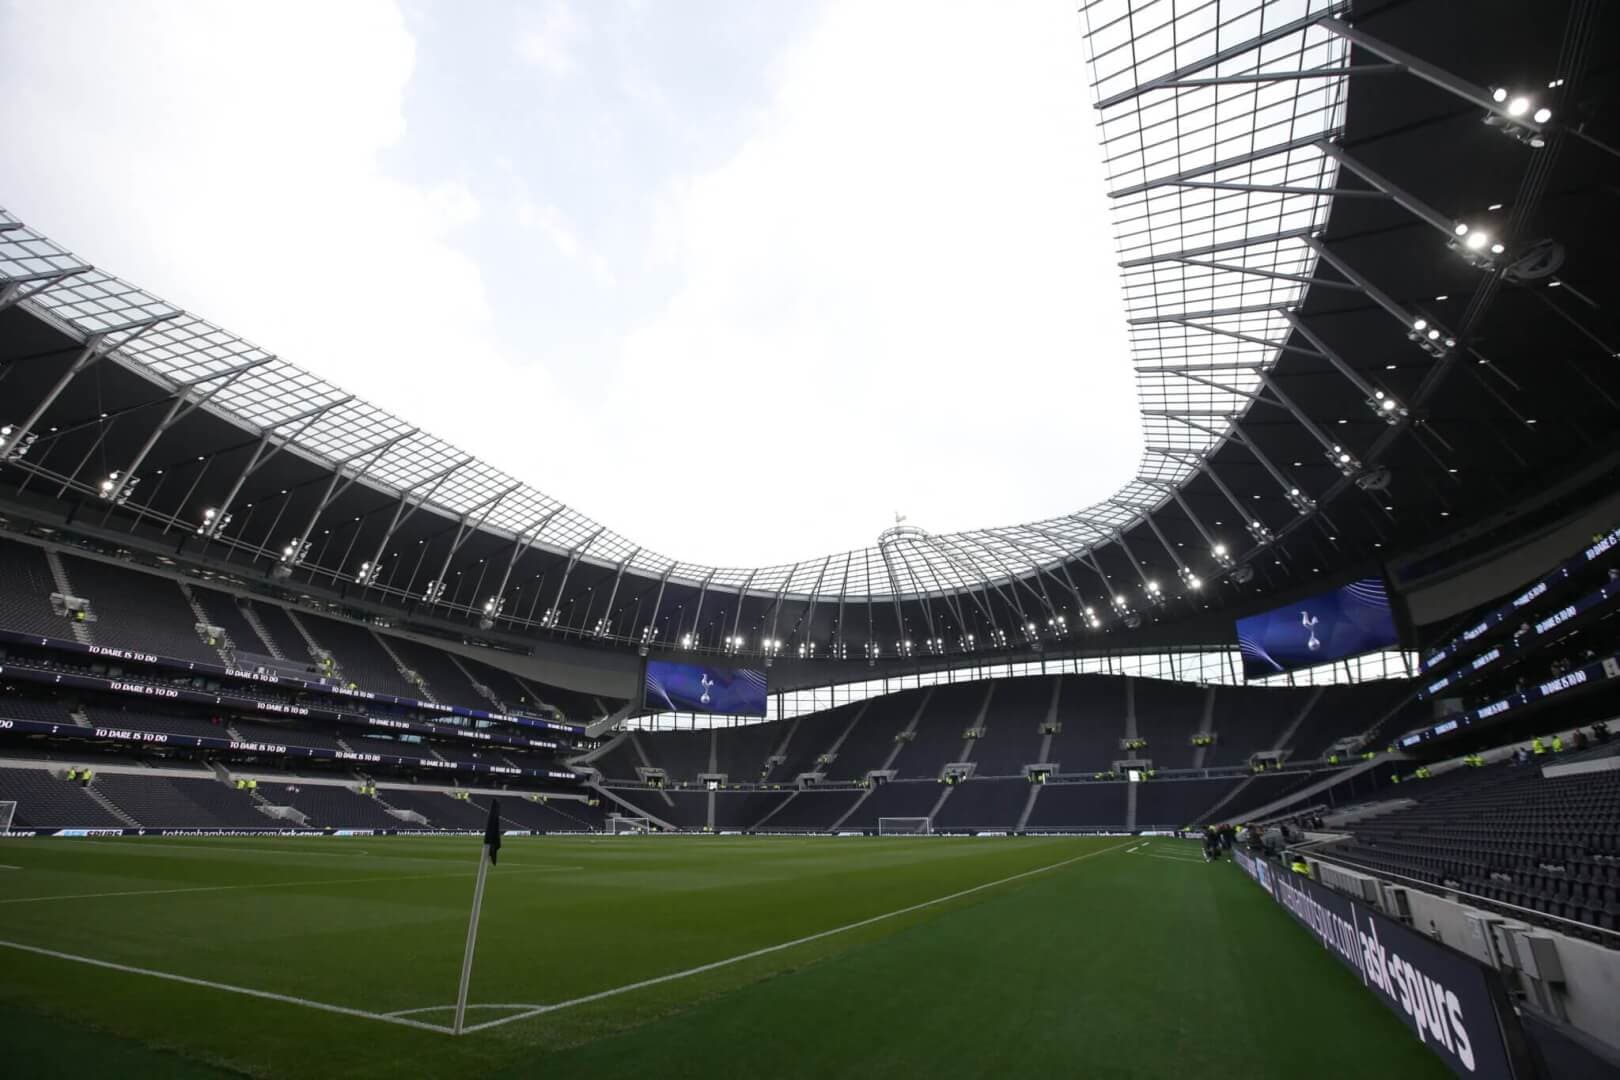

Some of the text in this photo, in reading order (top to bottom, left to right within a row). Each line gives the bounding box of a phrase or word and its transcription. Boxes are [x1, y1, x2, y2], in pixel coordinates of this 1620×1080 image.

[101, 648, 123, 658] DARE
[122, 684, 144, 693] DARE
[108, 731, 132, 739] DARE
